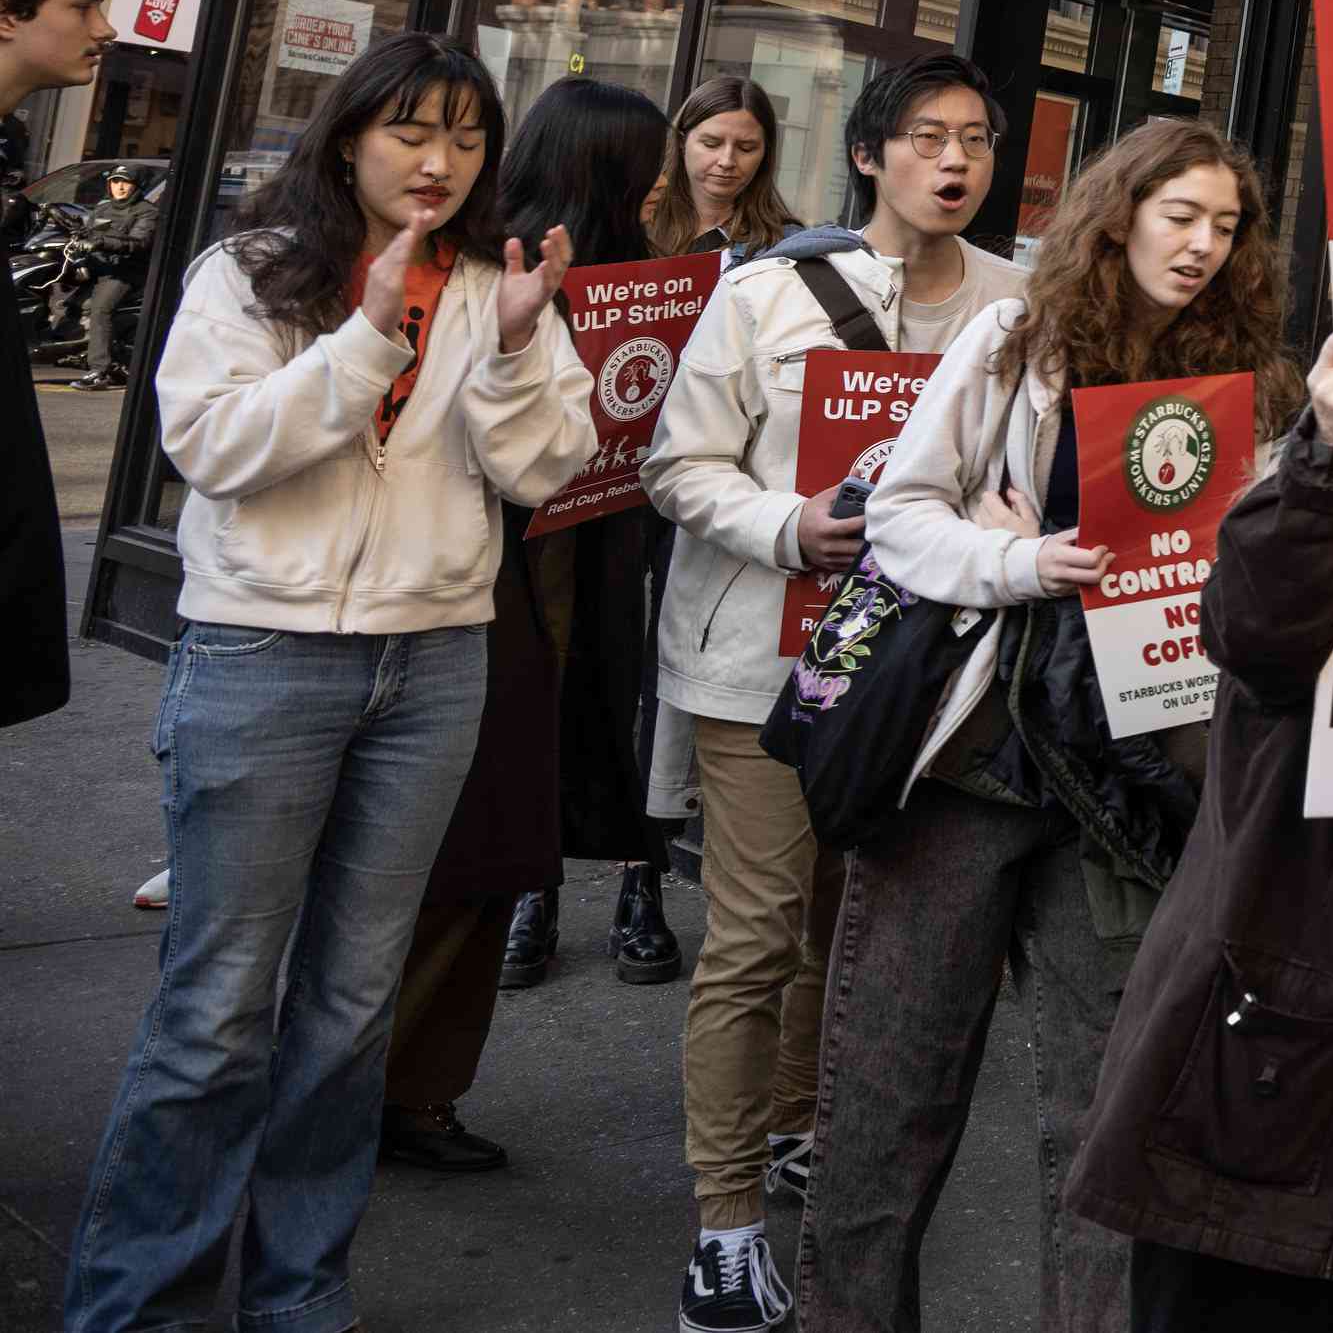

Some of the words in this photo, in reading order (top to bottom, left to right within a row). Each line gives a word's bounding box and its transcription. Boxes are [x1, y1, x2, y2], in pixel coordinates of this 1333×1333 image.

[586, 280, 659, 306] We're
[664, 276, 693, 293] on
[573, 306, 623, 333] ULP
[627, 296, 702, 326] Strike!
[609, 343, 668, 371] STARBUCKS
[603, 377, 636, 416] WORKERS
[641, 368, 669, 410] UNITED
[842, 370, 929, 397] We're
[823, 398, 882, 420] ULP
[1134, 402, 1207, 440] STARBUCKS
[1128, 449, 1172, 507] WORKERS
[1180, 441, 1212, 501] UNITED
[547, 498, 575, 516] Red
[576, 492, 604, 508] Cup
[1150, 529, 1191, 558] NO
[1100, 558, 1211, 599] CONTRA
[1164, 602, 1200, 629] NO
[1142, 634, 1206, 666] COF
[1118, 680, 1184, 703] STARBUCKS
[1186, 674, 1218, 689] WORK
[1162, 698, 1179, 709] ON
[1180, 692, 1200, 705] ULP
